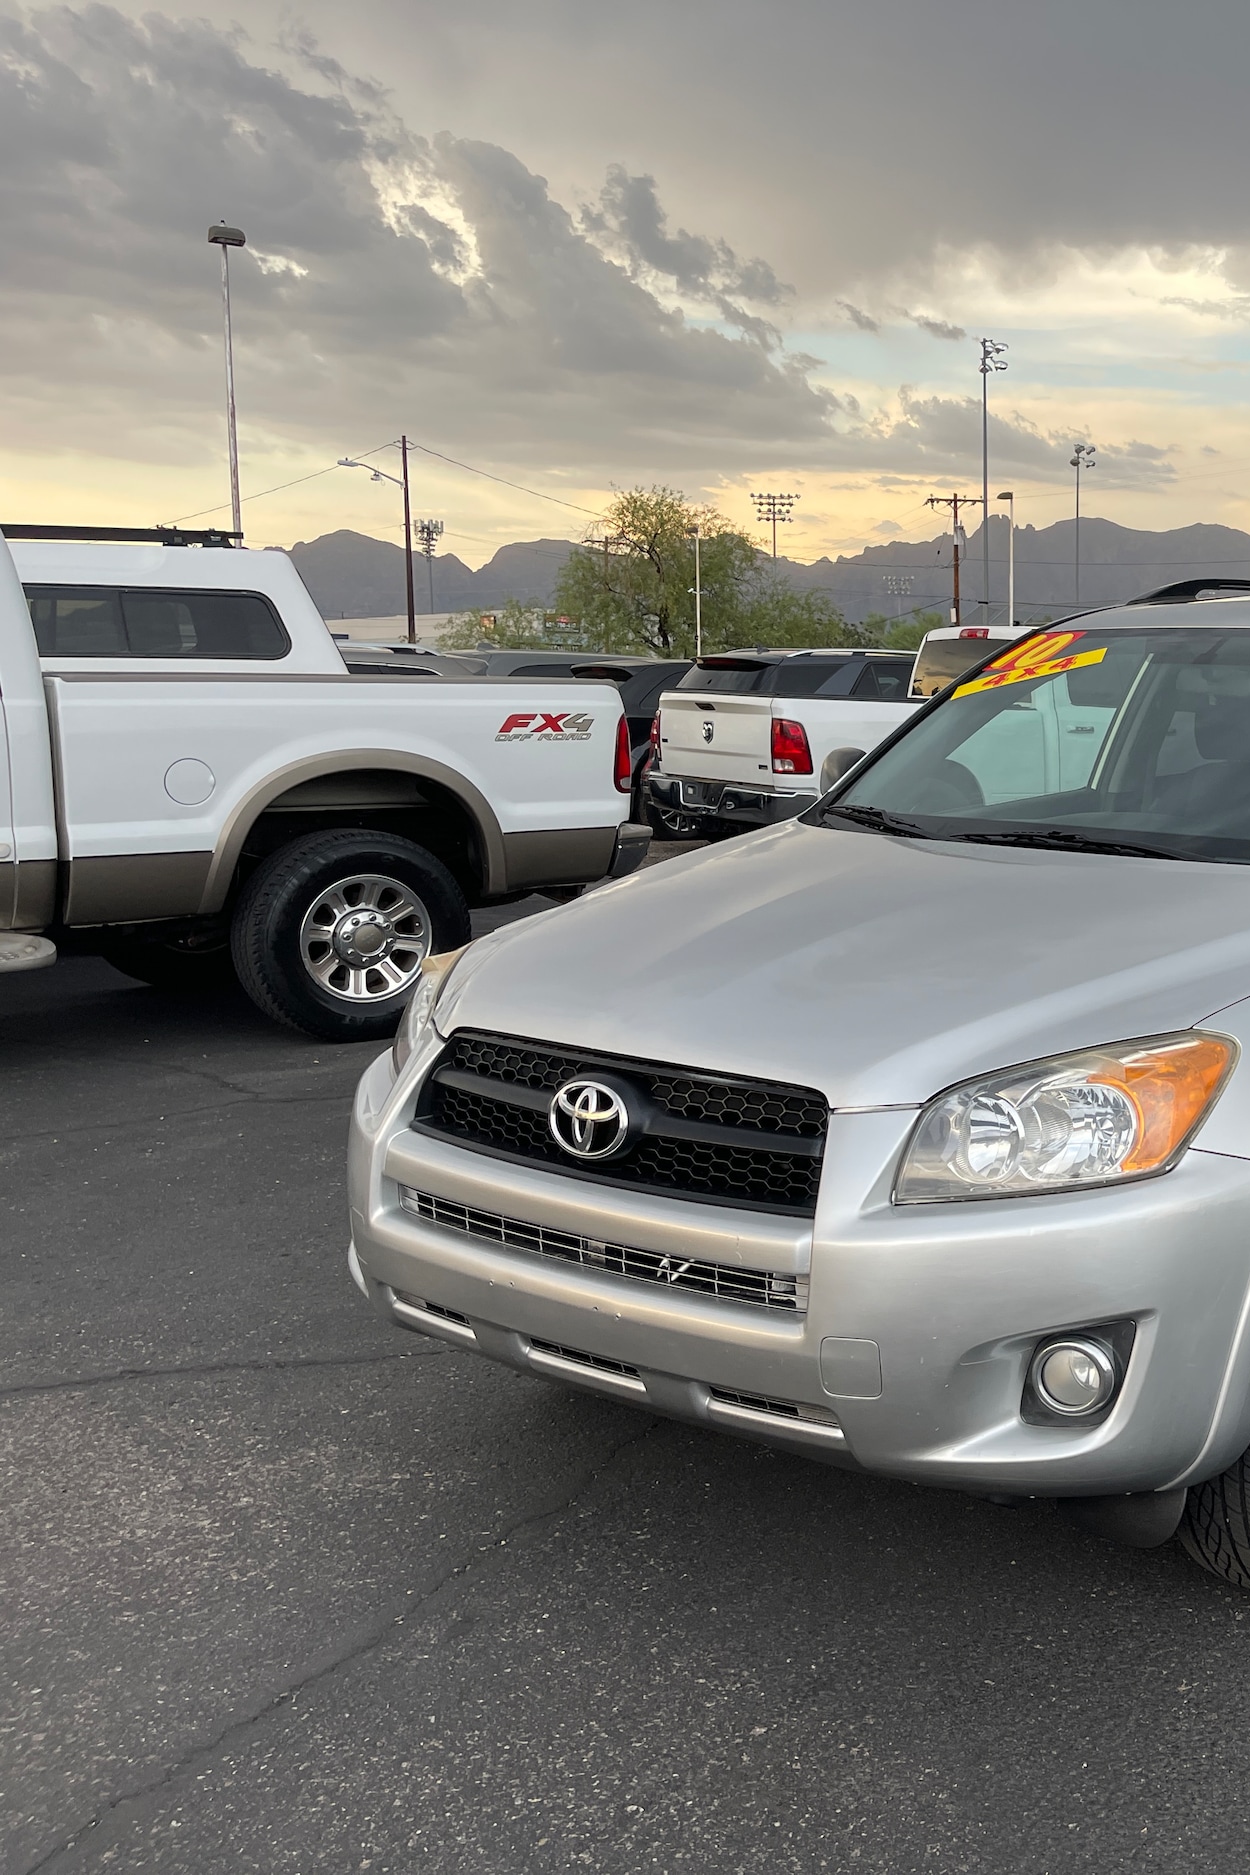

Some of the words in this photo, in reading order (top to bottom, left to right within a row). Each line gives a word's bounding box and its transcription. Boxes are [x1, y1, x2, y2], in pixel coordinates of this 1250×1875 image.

[990, 633, 1075, 669] 10
[498, 713, 595, 733] FX4
[494, 733, 534, 742] OFF
[537, 732, 592, 741] ROAD
